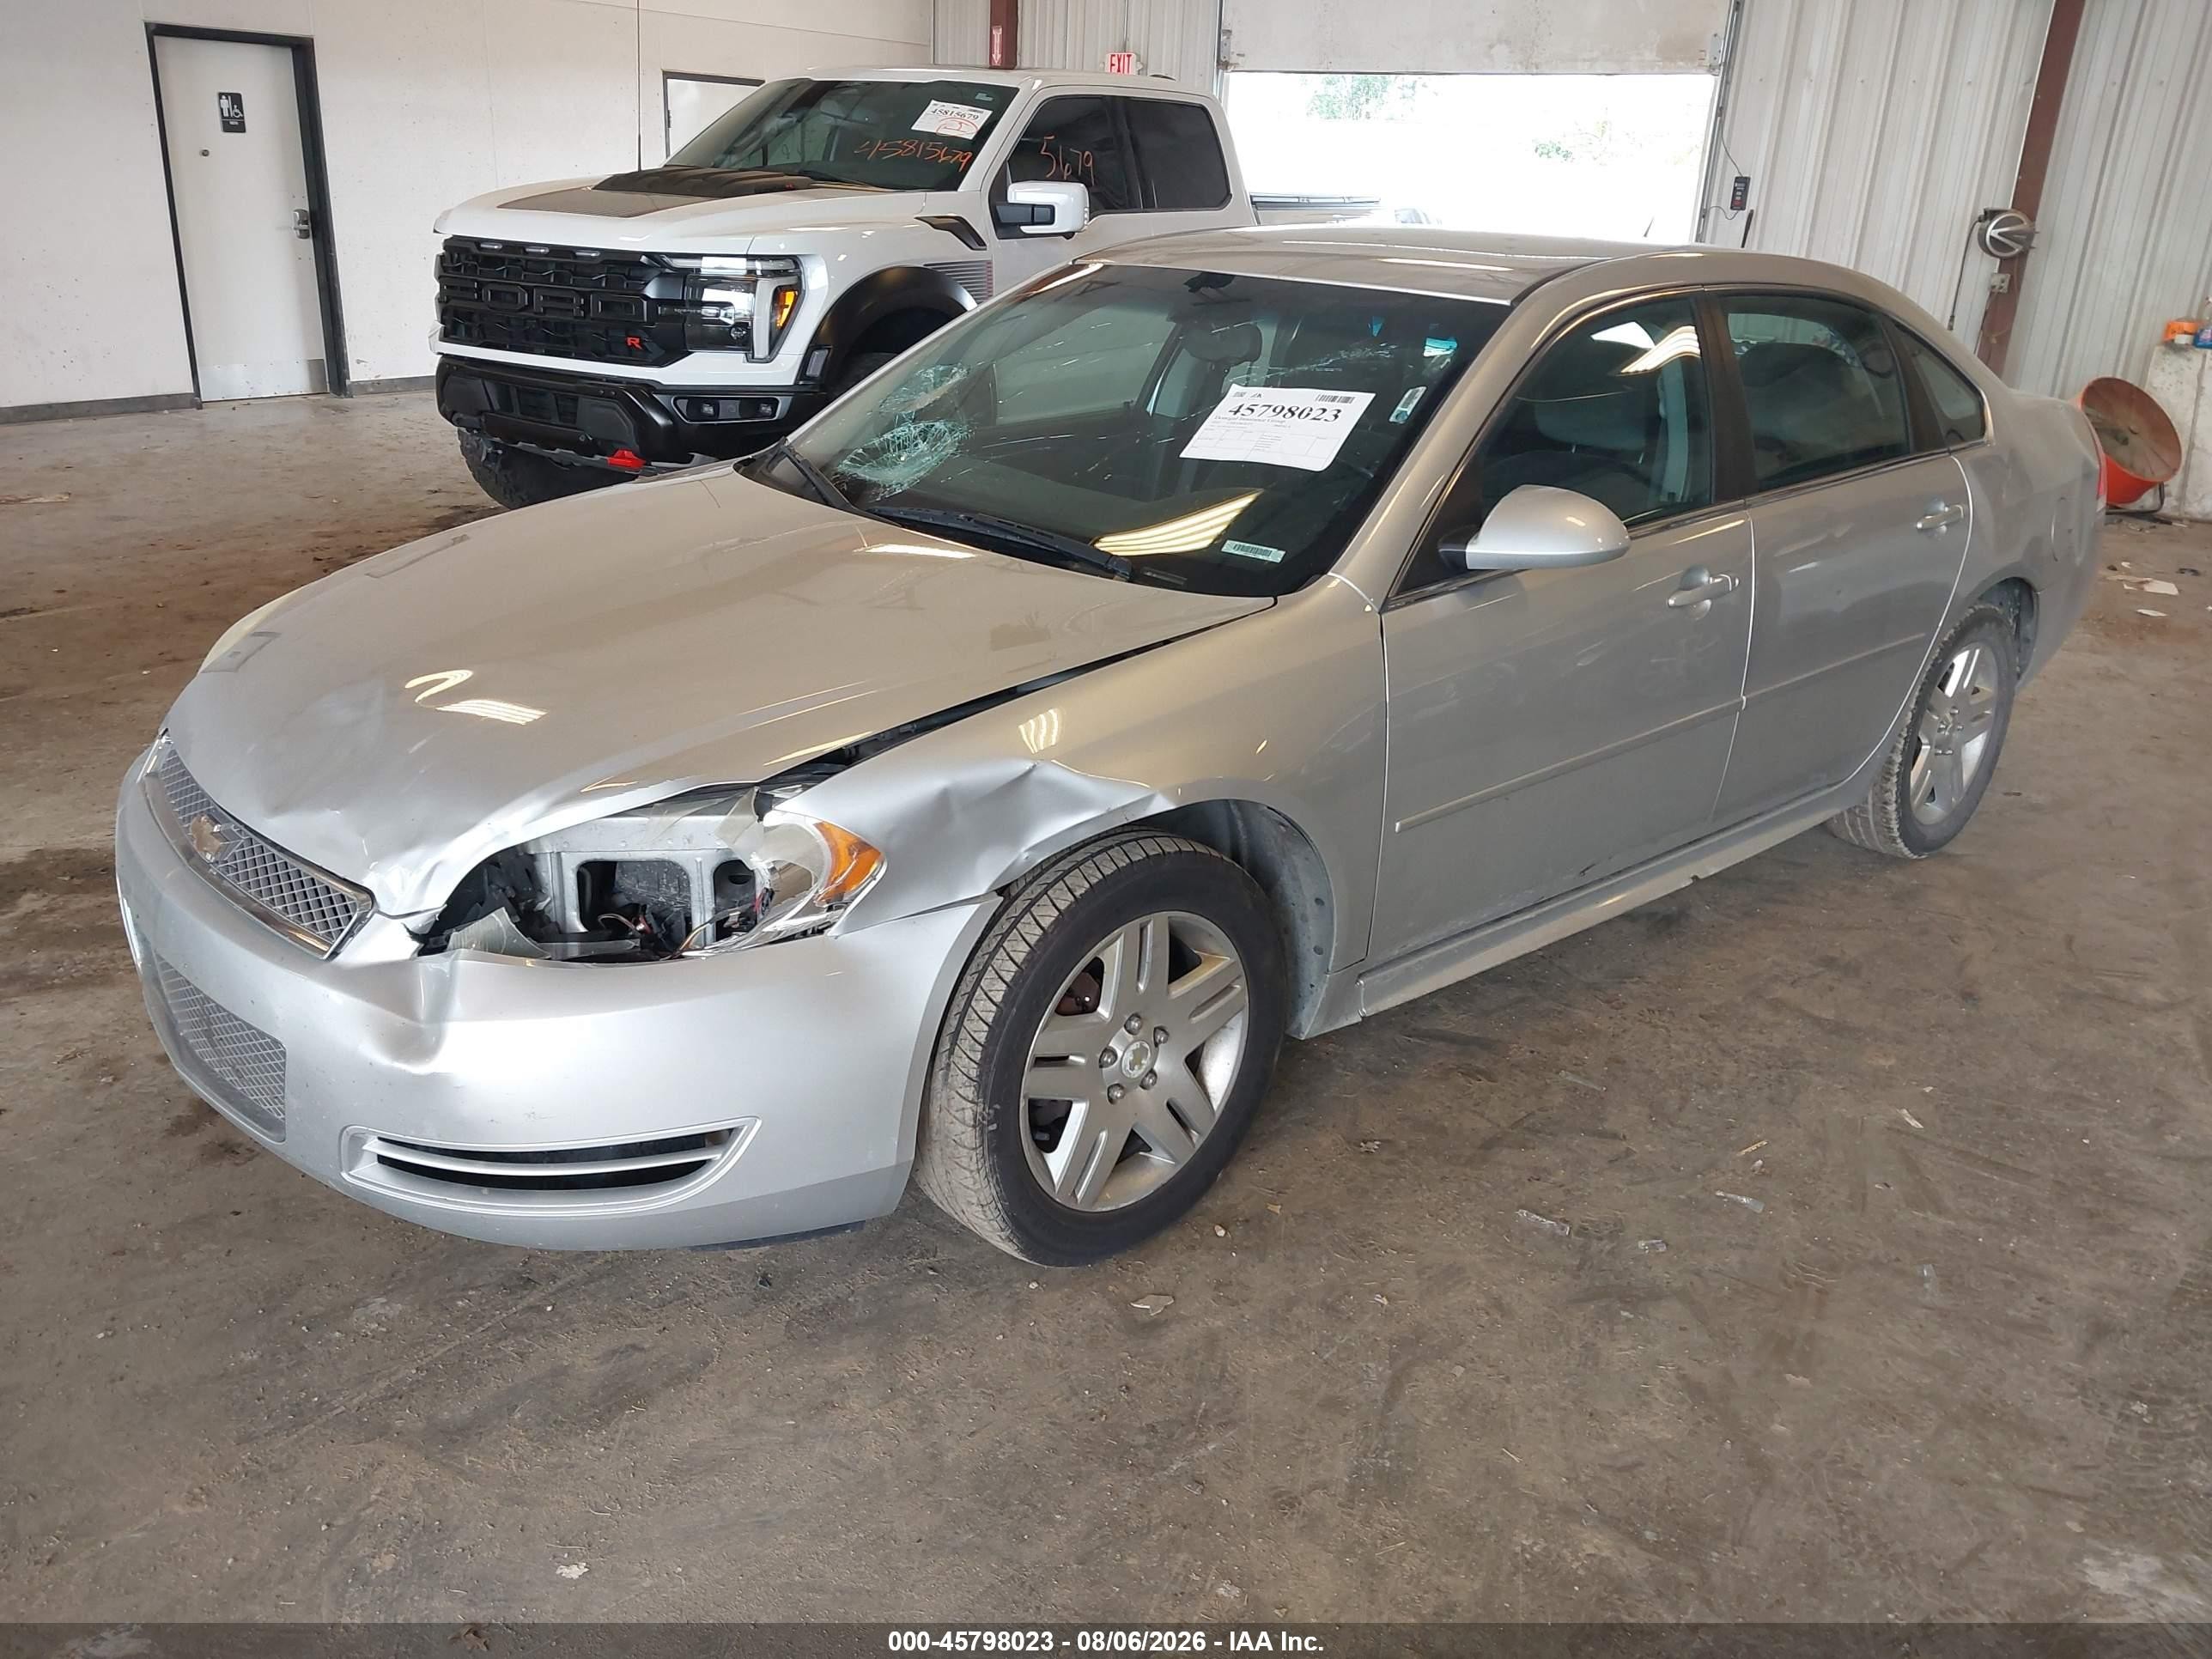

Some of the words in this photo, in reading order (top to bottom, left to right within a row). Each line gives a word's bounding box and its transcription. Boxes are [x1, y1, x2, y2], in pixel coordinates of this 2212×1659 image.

[1109, 53, 1132, 74] EXIT
[931, 108, 980, 121] 45815679
[854, 138, 973, 173] 45815679
[1040, 135, 1095, 186] 5679
[439, 276, 647, 324] FORD
[627, 337, 643, 350] R
[1228, 403, 1342, 422] 45798023
